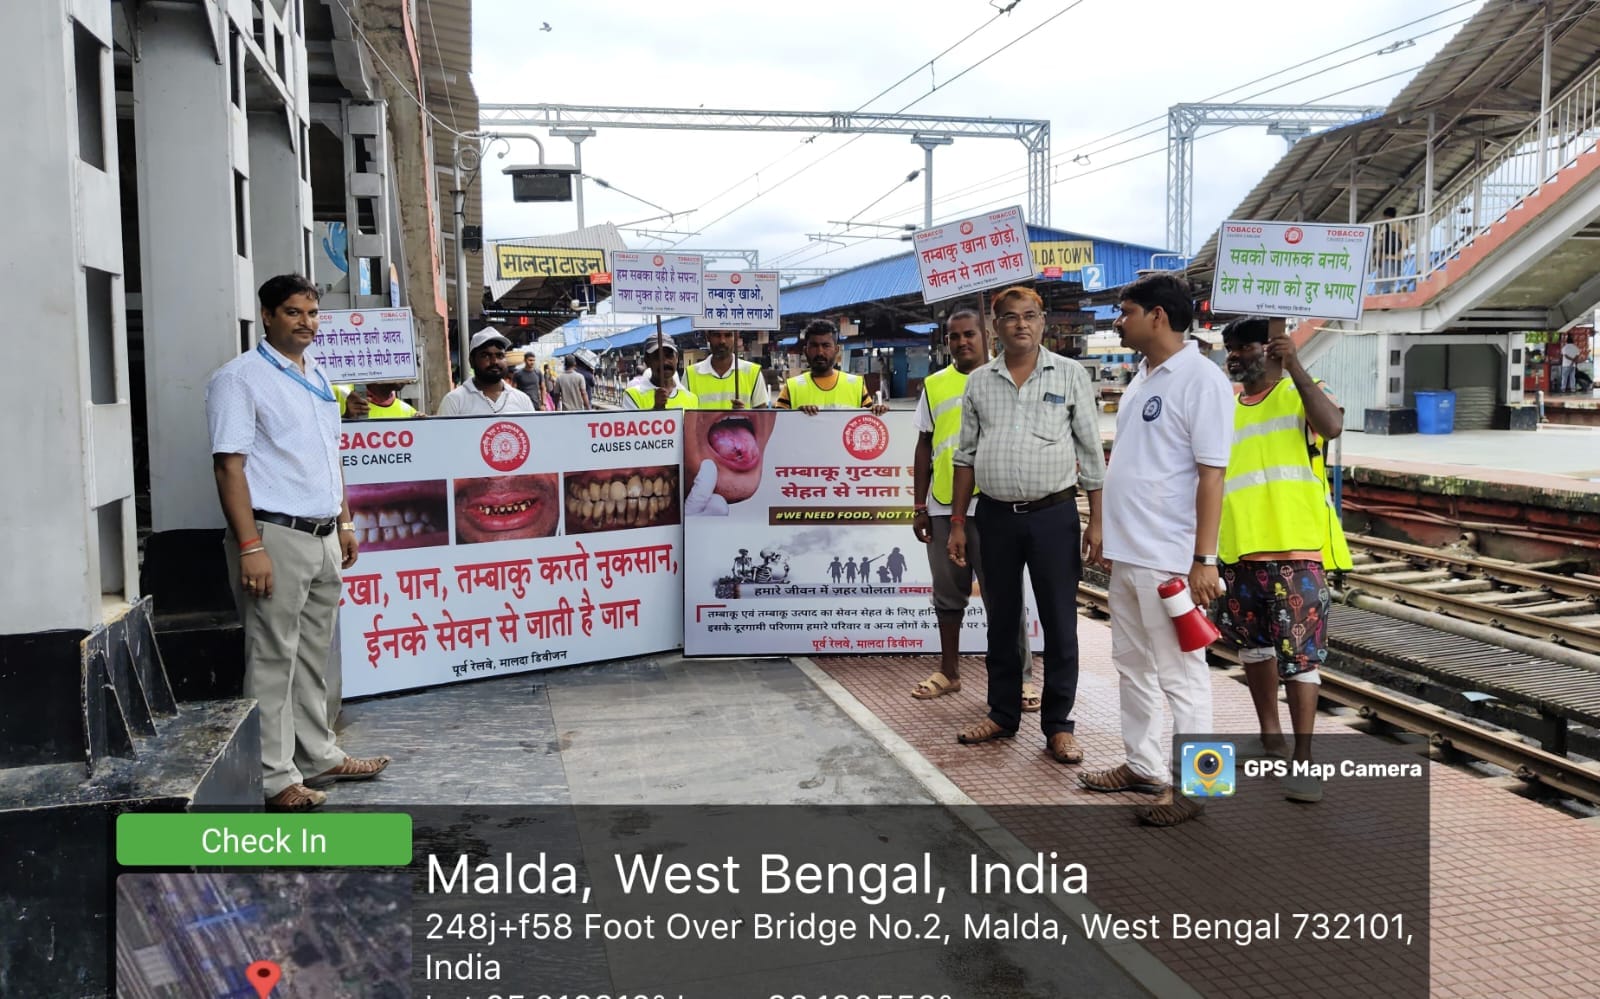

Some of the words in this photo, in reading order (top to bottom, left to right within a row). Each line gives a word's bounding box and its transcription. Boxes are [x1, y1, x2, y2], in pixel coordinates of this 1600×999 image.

[1226, 226, 1263, 234] TOBACCO
[1327, 229, 1365, 238] TOBACCO
[922, 242, 958, 264] तम्बाकु
[960, 235, 987, 254] खाना
[1032, 248, 1056, 266] LDA
[1057, 247, 1092, 265] TOWN
[1230, 243, 1267, 266] सबको
[501, 254, 557, 276] मालदा
[560, 256, 601, 274] टाउन
[616, 269, 628, 283] हम
[630, 269, 653, 282] सबका
[669, 265, 676, 284] है
[927, 268, 957, 288] जीवन
[958, 261, 970, 280] से
[973, 259, 996, 278] नाता
[1086, 267, 1104, 289] 2
[617, 288, 633, 300] नशा
[635, 289, 652, 305] मुक्त
[654, 286, 662, 303] हो
[664, 287, 676, 303] देश
[678, 292, 699, 303] अपना
[738, 284, 764, 301] खाओ,
[1220, 272, 1239, 295] देश
[1242, 272, 1254, 295] से
[1256, 278, 1281, 296] नशा
[1284, 274, 1302, 297] को
[1324, 282, 1357, 304] भगाए
[715, 304, 728, 320] को
[730, 304, 744, 320] गले
[746, 304, 774, 320] लगाओ
[326, 328, 338, 346] की
[339, 327, 361, 346] जिसने
[328, 348, 343, 368] मौत
[344, 350, 356, 368] को
[366, 347, 373, 368] है
[393, 352, 411, 366] दावत
[588, 418, 676, 439] TOBACCO
[339, 430, 414, 450] BACCO
[591, 440, 632, 453] CAUSES
[635, 438, 675, 451] CANCER
[361, 453, 412, 465] CANCER
[775, 465, 840, 481] तम्बाकू
[845, 465, 901, 481] गुटखा
[781, 482, 827, 500] सेहत
[833, 482, 851, 498] से
[856, 486, 901, 497] नाता
[775, 511, 802, 520] #WE
[804, 511, 835, 520] NEED
[837, 511, 873, 521] FOOD,
[876, 511, 902, 519] NOT
[396, 567, 448, 602] पान,
[454, 558, 533, 599] तम्बाकु
[537, 541, 590, 585] करते
[594, 543, 679, 590] नुकसान,
[754, 585, 781, 596] हमारे
[784, 585, 816, 596] जीवन
[820, 585, 829, 595] में
[707, 609, 739, 620] तम्बाकू
[758, 609, 788, 620] तम्बाकू
[835, 607, 857, 617] सेवन
[860, 607, 882, 617] सेहत
[884, 607, 895, 617] के
[896, 607, 915, 617] लिए
[967, 607, 983, 617] होने
[363, 613, 429, 669] ईनके
[433, 609, 492, 652] सेवन
[496, 602, 519, 644] से
[524, 597, 575, 639] जाती
[579, 588, 596, 637] है
[599, 598, 642, 630] जान
[707, 622, 732, 633] इसके
[769, 622, 803, 631] परिणाम
[806, 621, 829, 631] हमारे
[831, 622, 862, 631] परिवार
[873, 622, 893, 630] अन्य
[920, 621, 930, 630] के
[812, 636, 827, 651] पूर्व
[856, 639, 885, 649] मालदा
[452, 659, 468, 677] पूर्व
[470, 658, 496, 671] रेलवे,
[499, 655, 529, 667] मालदा
